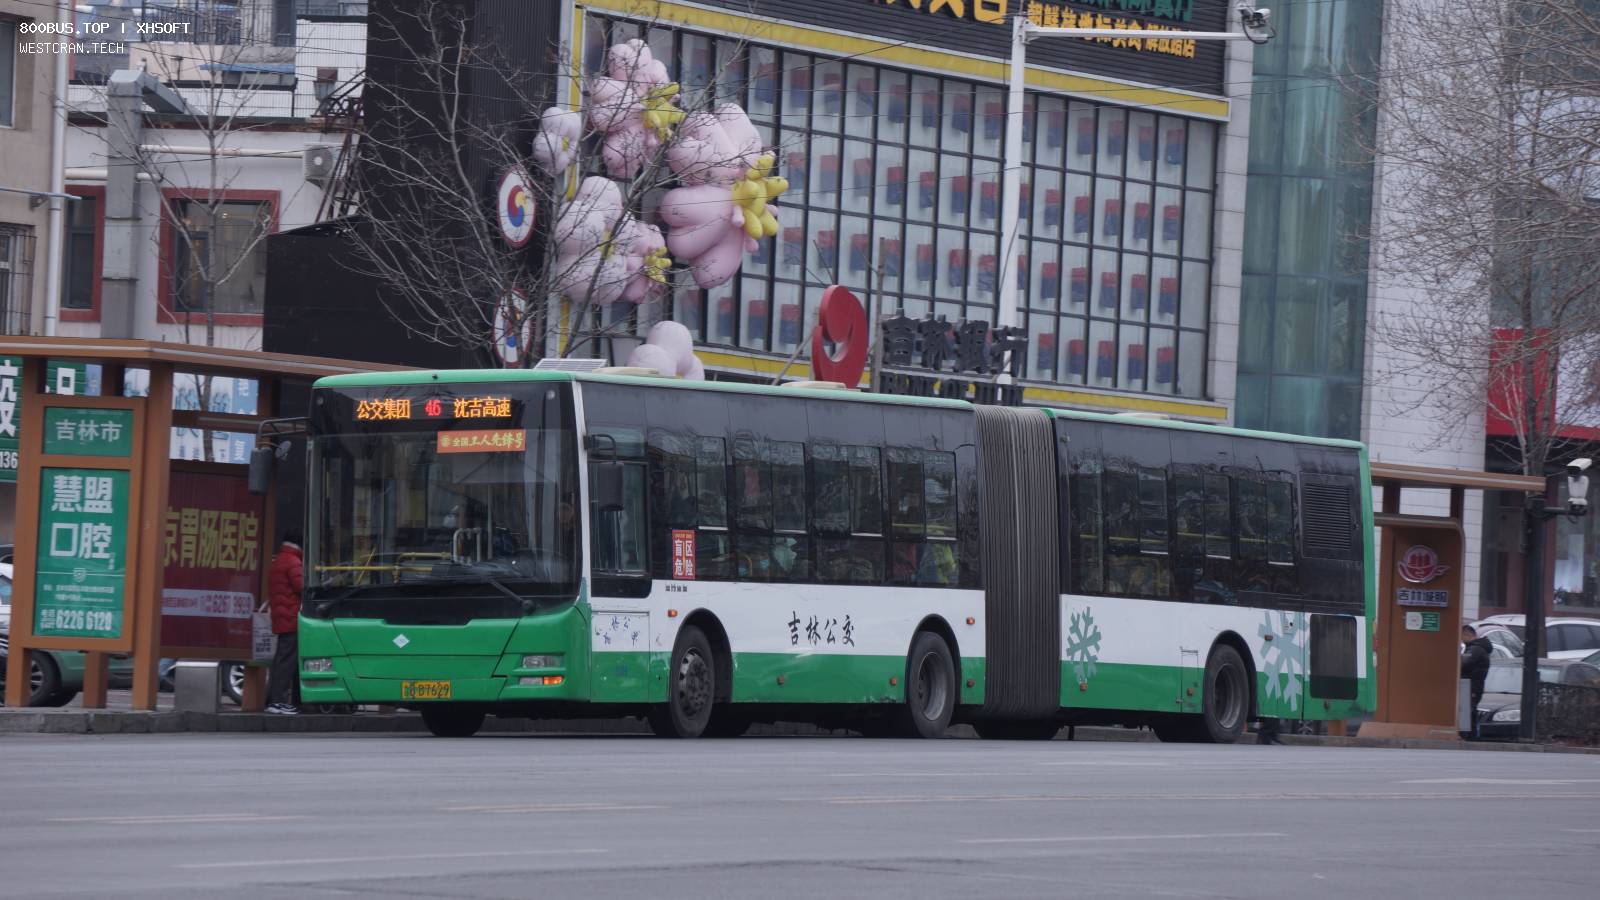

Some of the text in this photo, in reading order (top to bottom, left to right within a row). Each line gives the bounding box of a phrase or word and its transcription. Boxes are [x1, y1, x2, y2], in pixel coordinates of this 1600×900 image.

[356, 396, 512, 420] 公交集团 46 沈吉高速
[55, 418, 123, 442] 吉林市
[51, 475, 113, 514] 慧盟
[49, 522, 113, 559] 口腔
[675, 538, 693, 557] 盲区
[675, 558, 693, 576] 危险
[56, 609, 84, 630] 6226
[787, 610, 855, 648] 吉林公交
